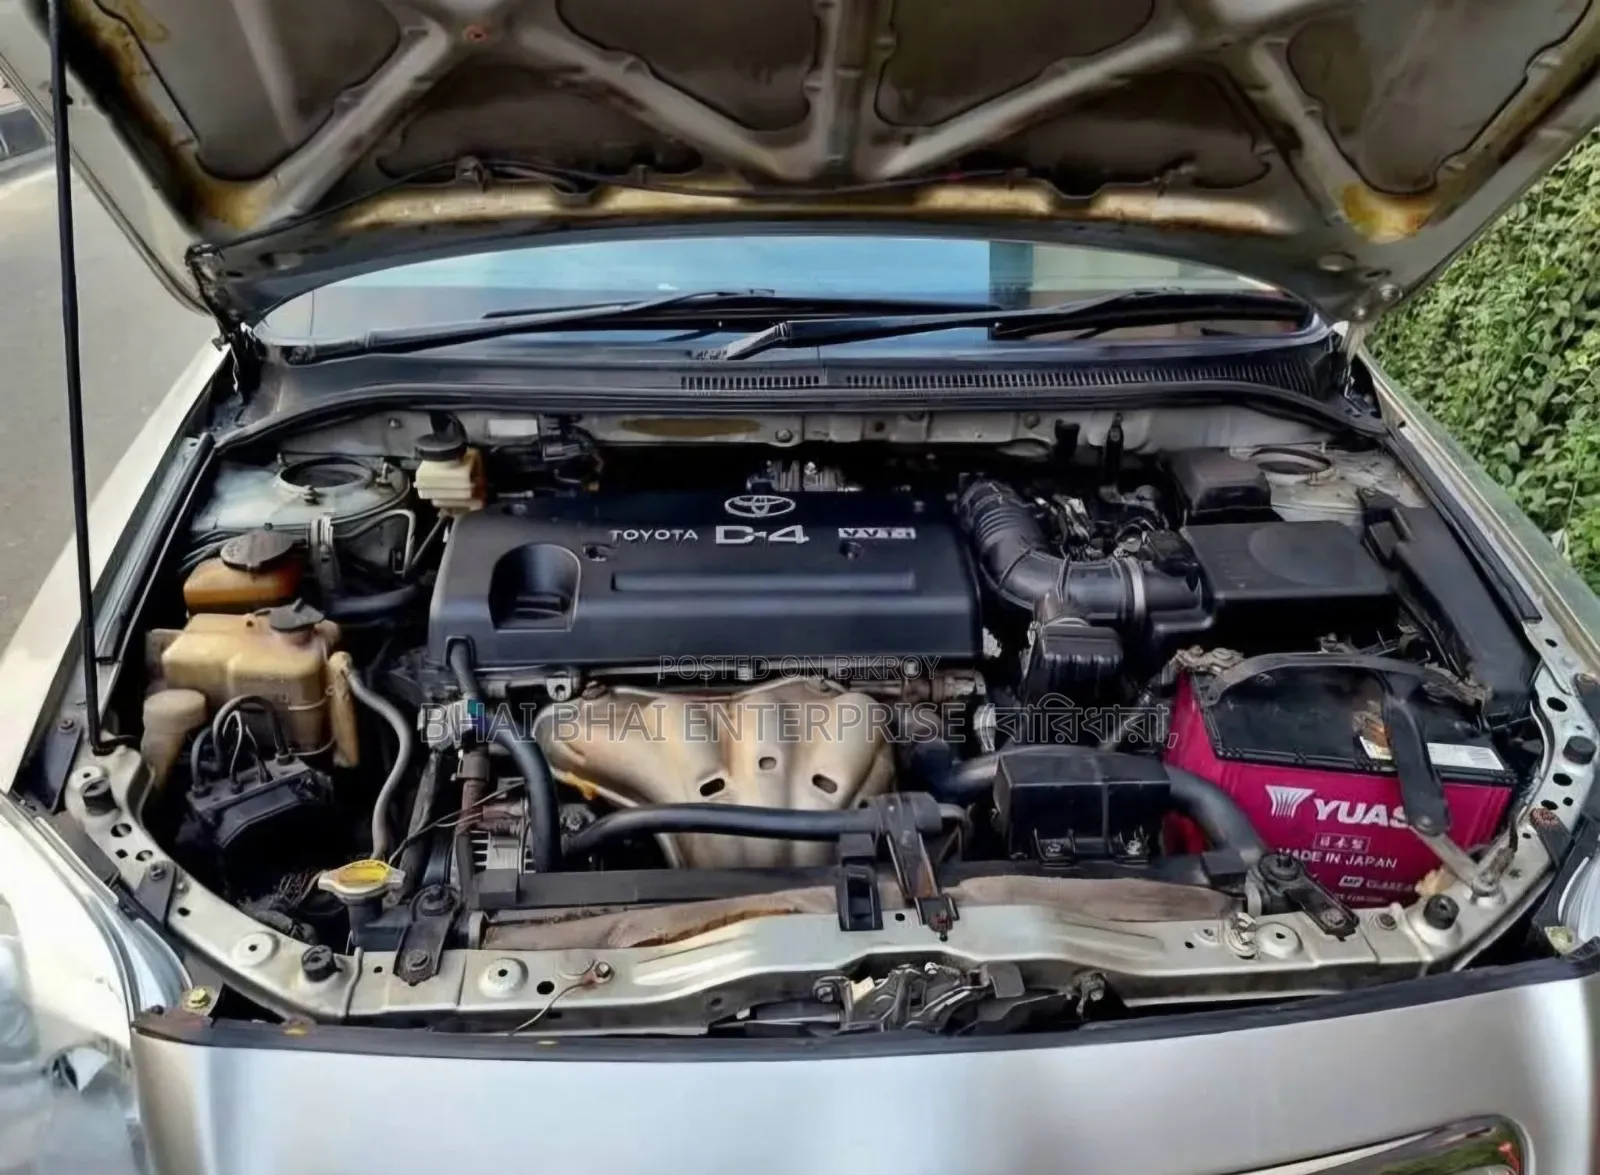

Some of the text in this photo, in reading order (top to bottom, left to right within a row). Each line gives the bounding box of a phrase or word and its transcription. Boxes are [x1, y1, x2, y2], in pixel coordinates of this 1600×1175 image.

[608, 529, 698, 542] TOYOTA
[715, 525, 809, 544] D-4
[1313, 798, 1410, 828] YUAS
[1325, 853, 1341, 864] IN
[1346, 855, 1398, 869] JAPAN
